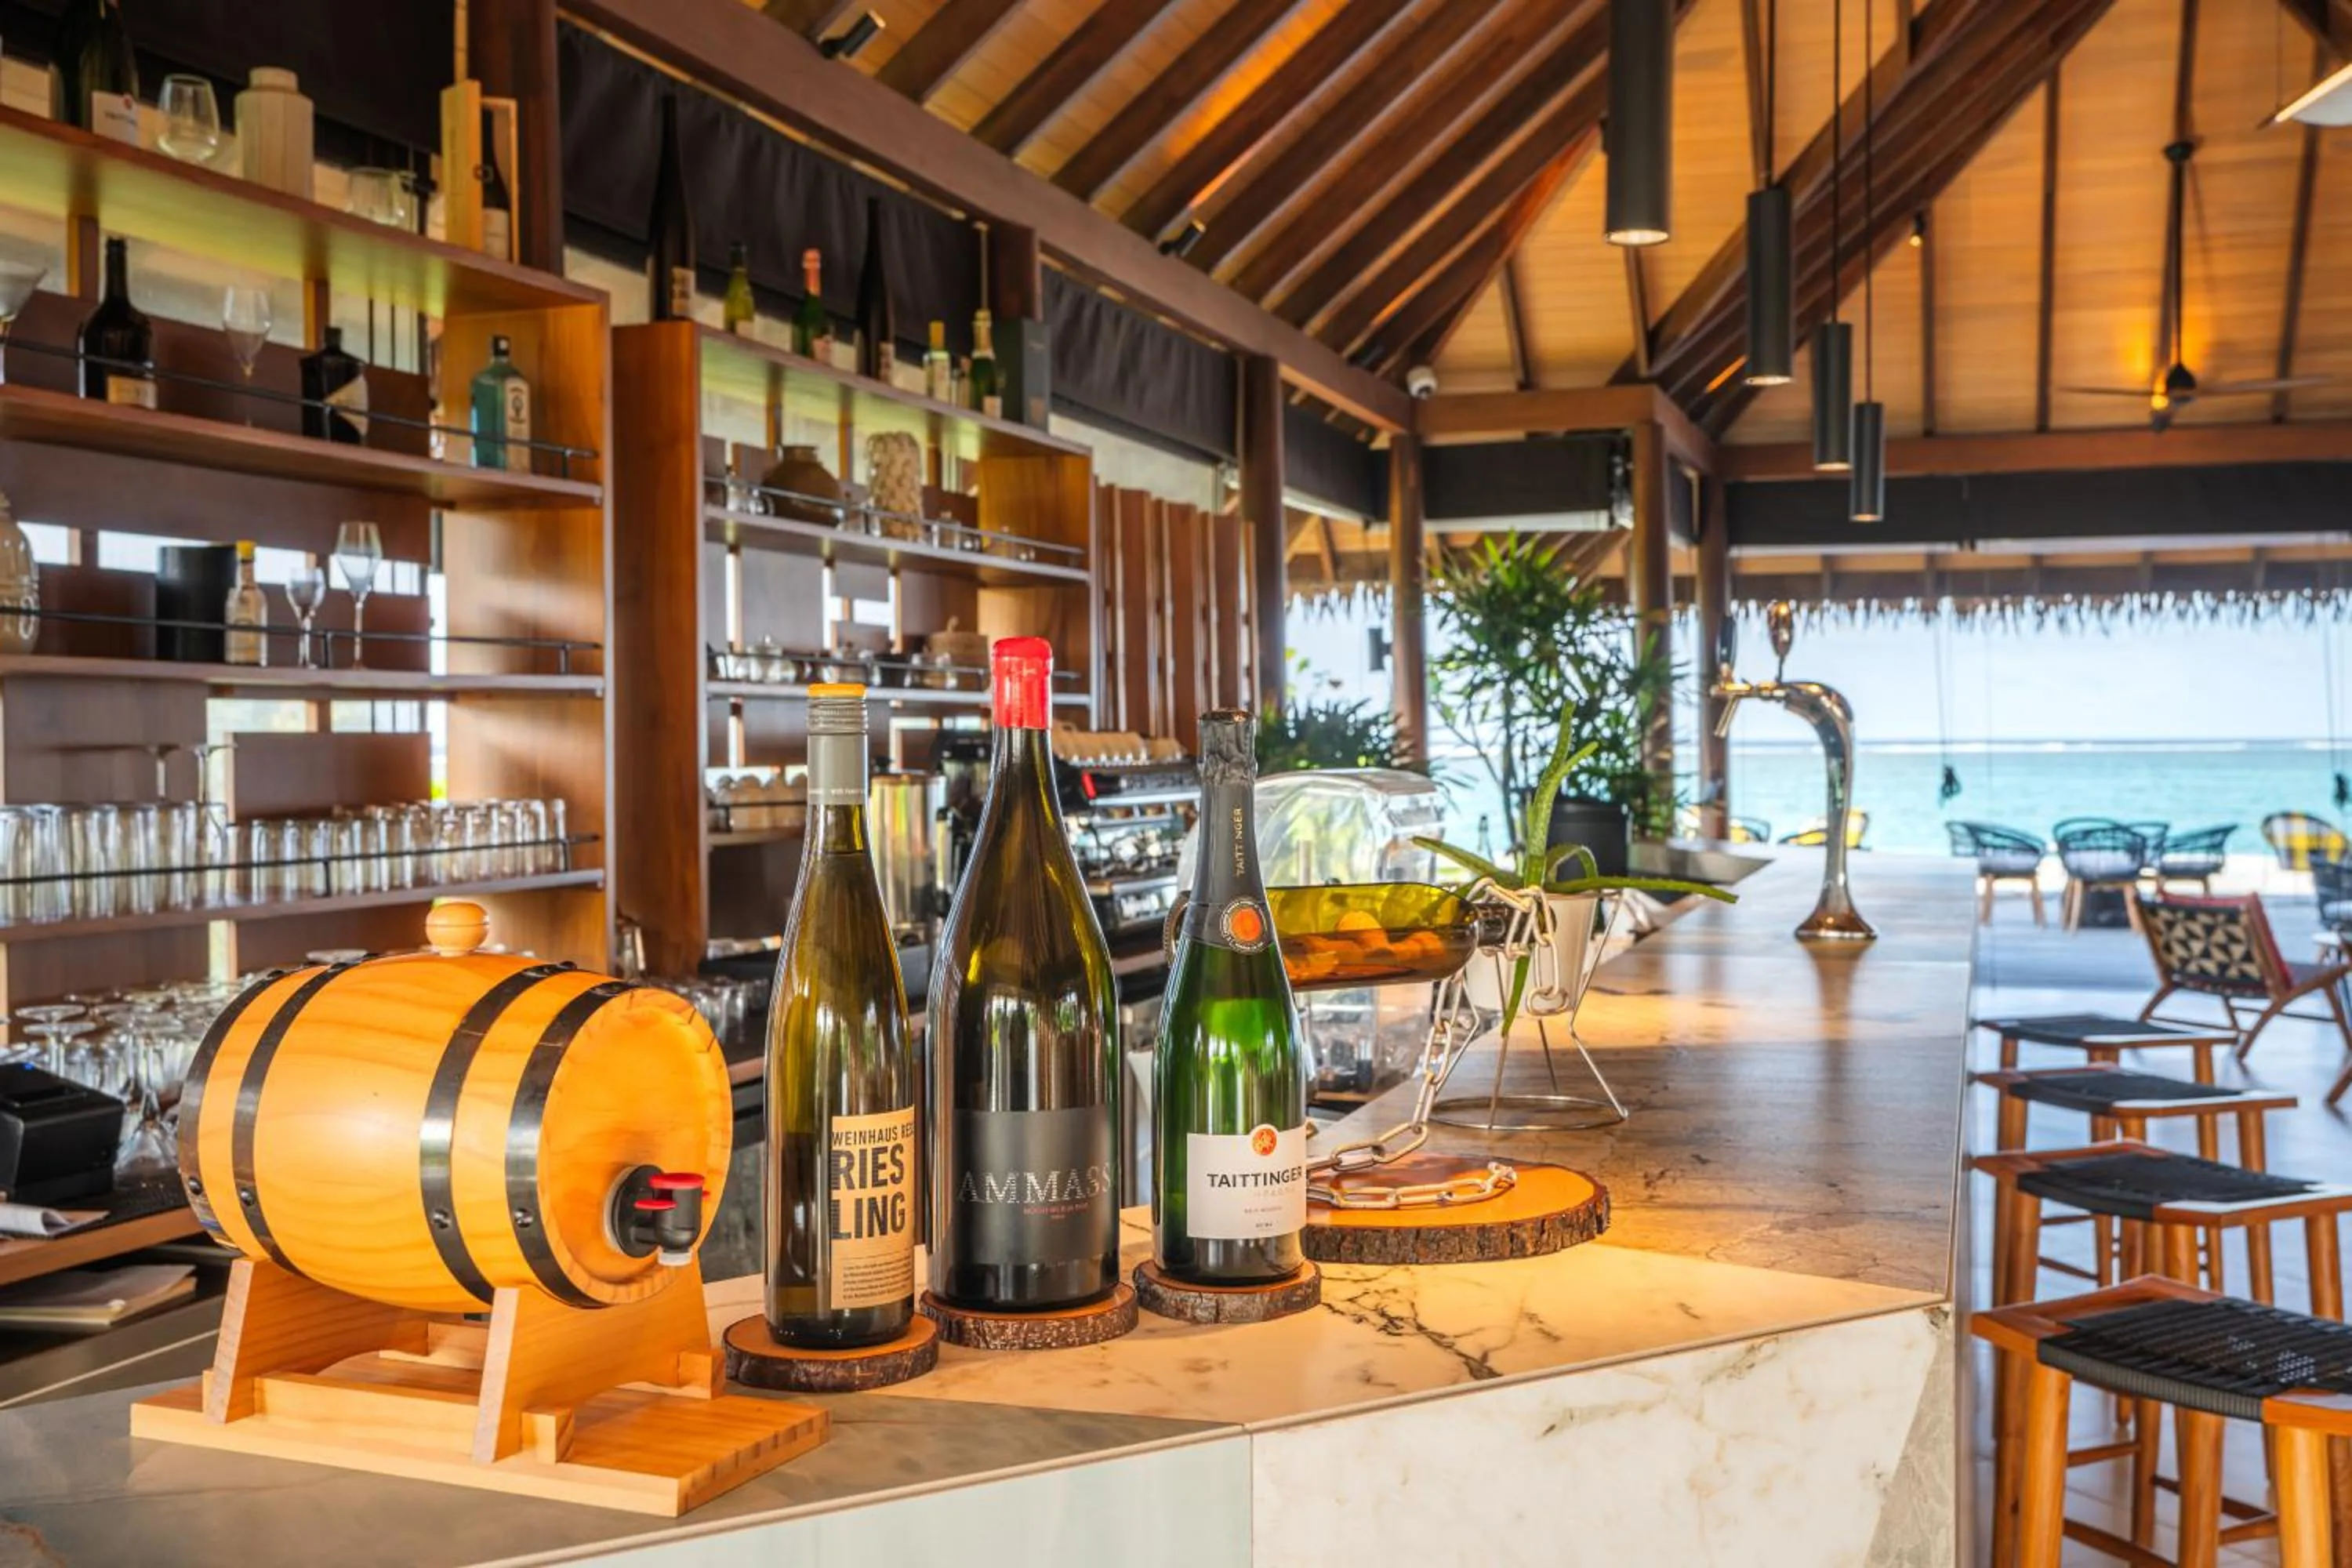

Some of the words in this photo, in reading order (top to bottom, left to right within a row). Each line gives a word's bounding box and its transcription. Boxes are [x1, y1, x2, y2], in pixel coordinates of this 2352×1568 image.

[1232, 808, 1244, 877] TAITTNGER
[832, 1126, 898, 1146] WEINHAUS
[831, 1143, 904, 1190] RIES
[831, 1191, 906, 1240] LING
